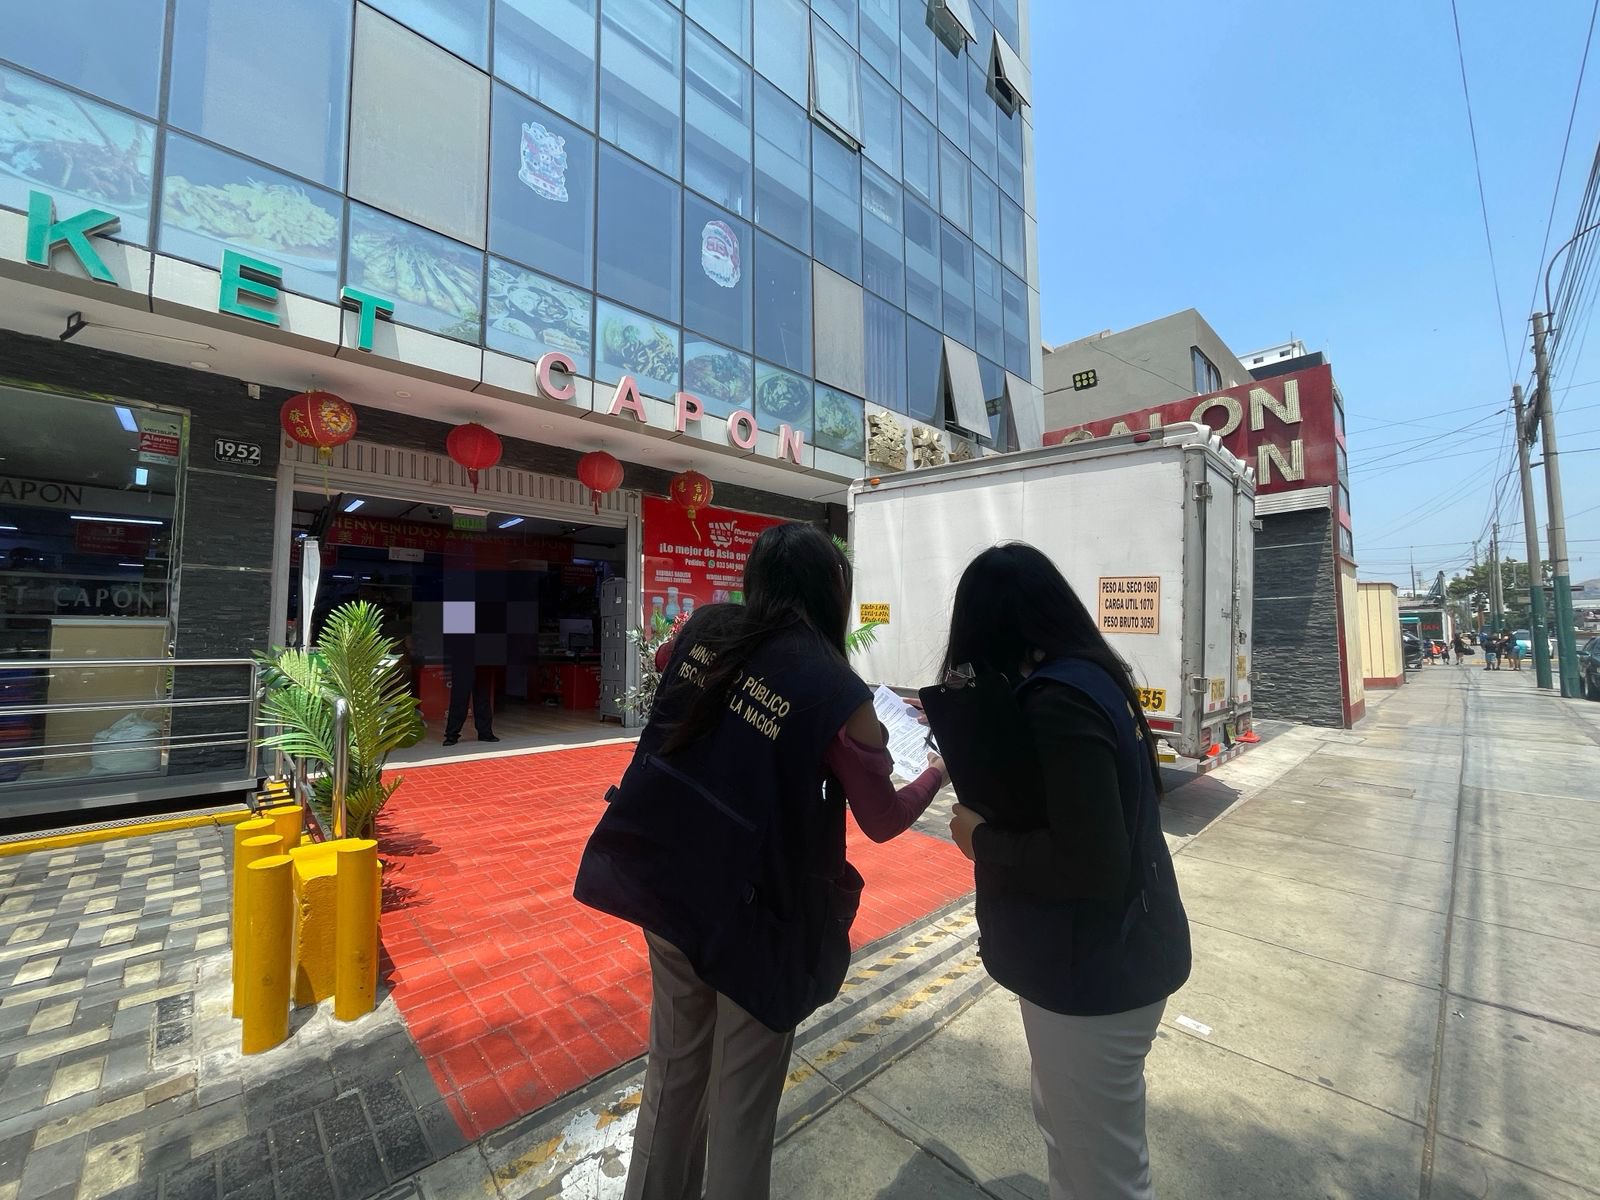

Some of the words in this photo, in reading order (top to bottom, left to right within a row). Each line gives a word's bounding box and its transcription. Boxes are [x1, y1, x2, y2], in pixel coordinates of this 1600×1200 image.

[535, 351, 805, 465] CAPON
[143, 433, 178, 444] Alarma
[217, 441, 260, 460] 1952
[659, 543, 674, 553] ¡Lo
[675, 545, 703, 557] mejor
[704, 547, 715, 558] de
[716, 548, 735, 560] Asia
[736, 553, 747, 561] en
[1102, 582, 1117, 593] PESO
[1117, 582, 1125, 593] AL
[1126, 581, 1142, 593] SECO
[1143, 581, 1158, 593] 1980
[53, 586, 154, 609] CAPON
[1104, 598, 1124, 610] CARGA
[1125, 598, 1138, 610] UTIL
[1140, 598, 1154, 610] 1070
[1103, 616, 1118, 627] PESO
[1119, 616, 1139, 628] BRUTO
[1140, 616, 1155, 628] 3050
[742, 676, 790, 717] PÚBLICO
[729, 694, 743, 714] LA
[743, 704, 781, 741] NACIÓN
